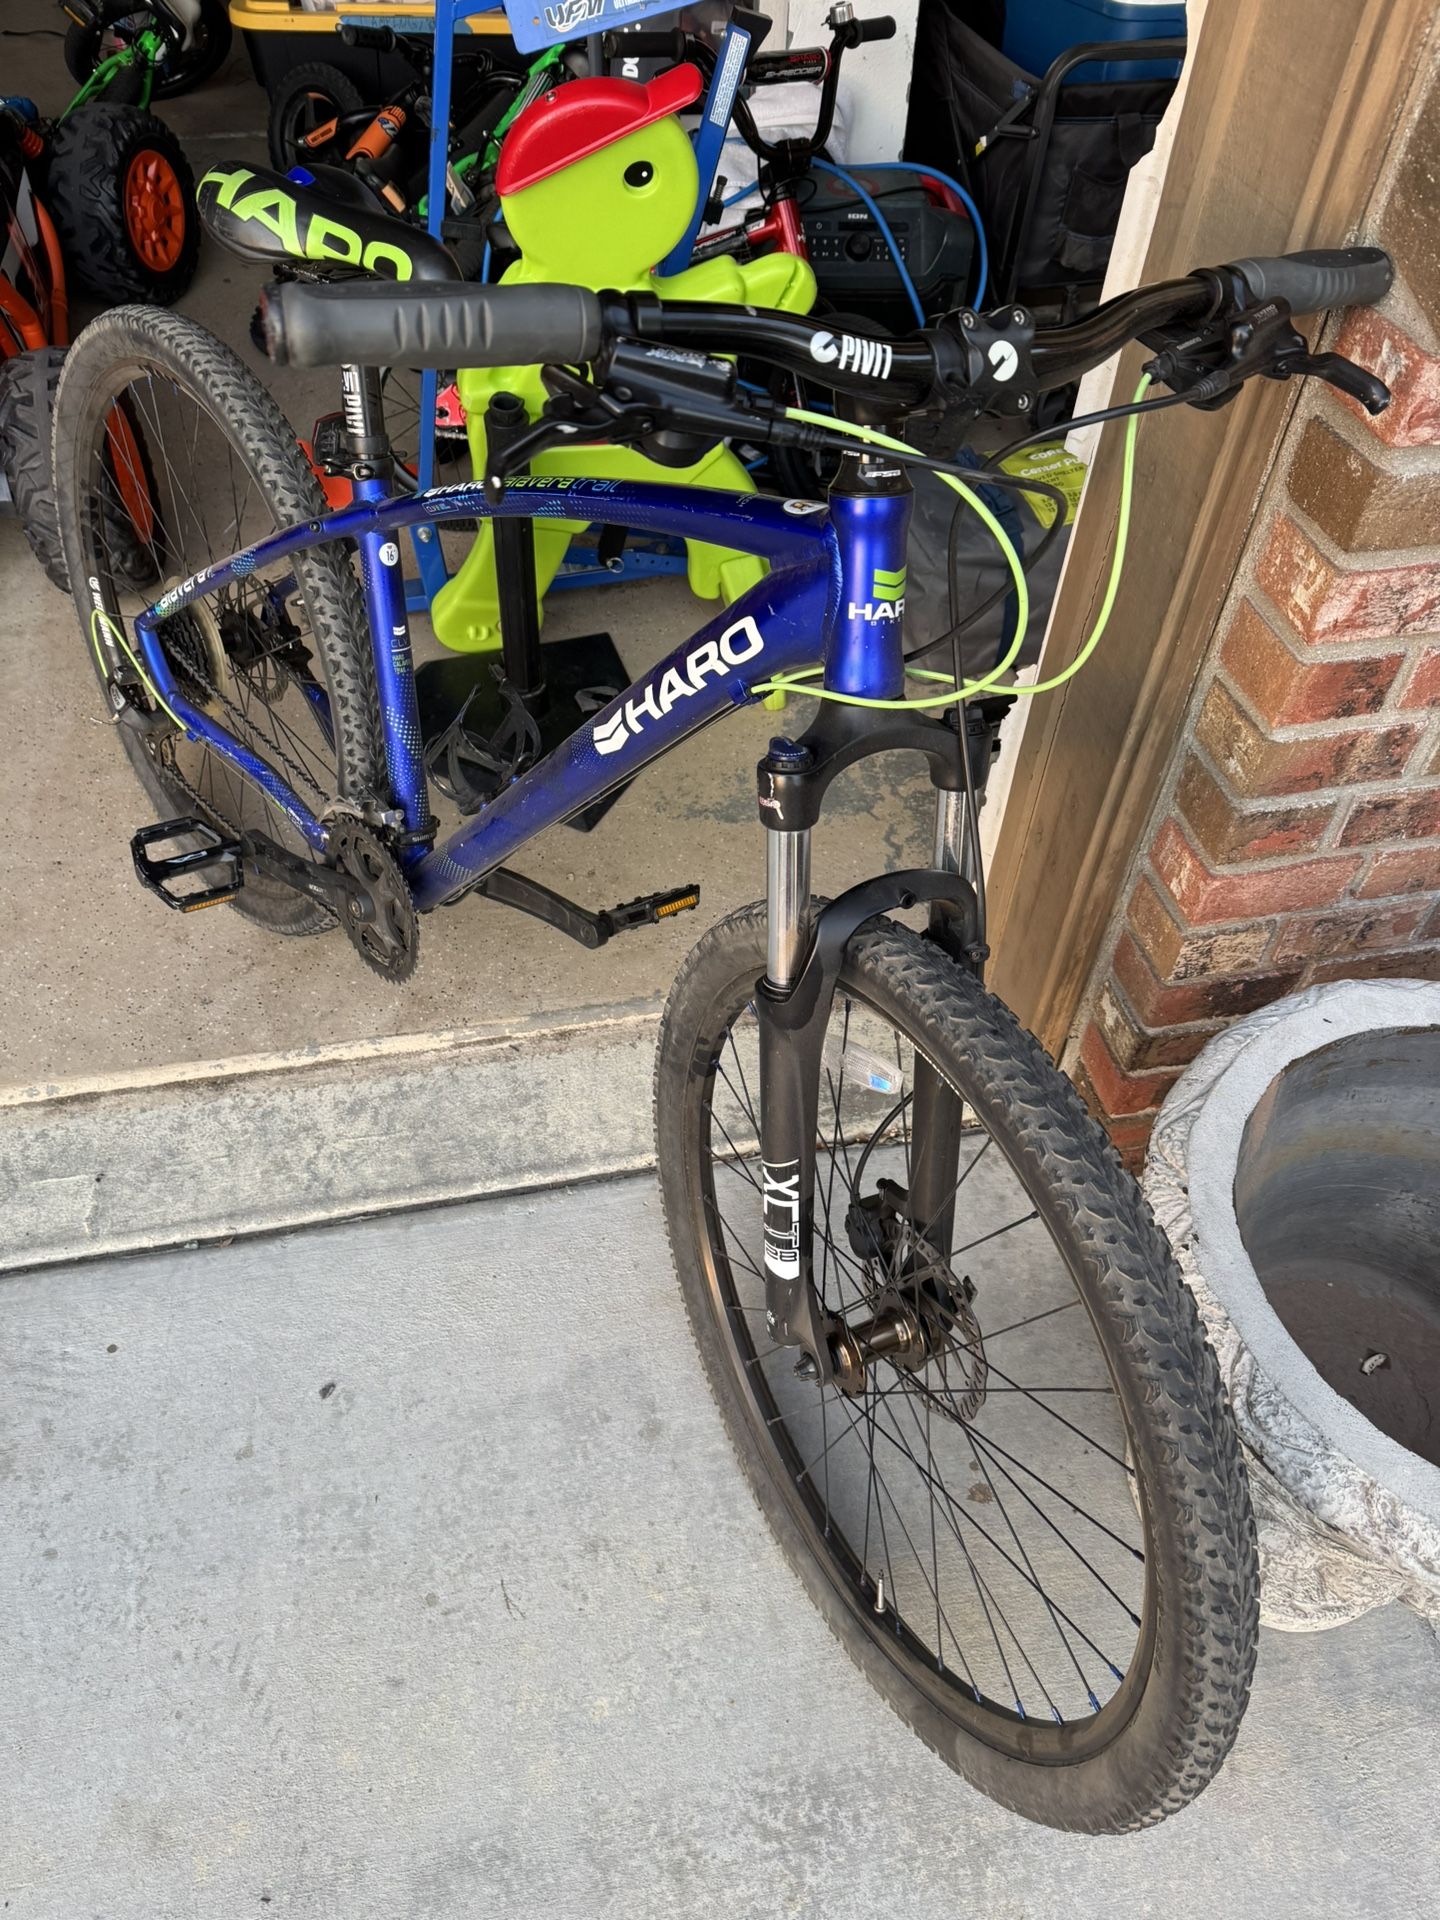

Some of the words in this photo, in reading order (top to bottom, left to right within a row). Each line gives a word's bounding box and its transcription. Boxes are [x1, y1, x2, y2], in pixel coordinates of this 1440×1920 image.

[848, 212, 868, 220] ION
[343, 394, 366, 438] PIVI
[504, 477, 572, 489] alavera
[91, 591, 115, 648] WEIMANN
[625, 615, 764, 735] HARO
